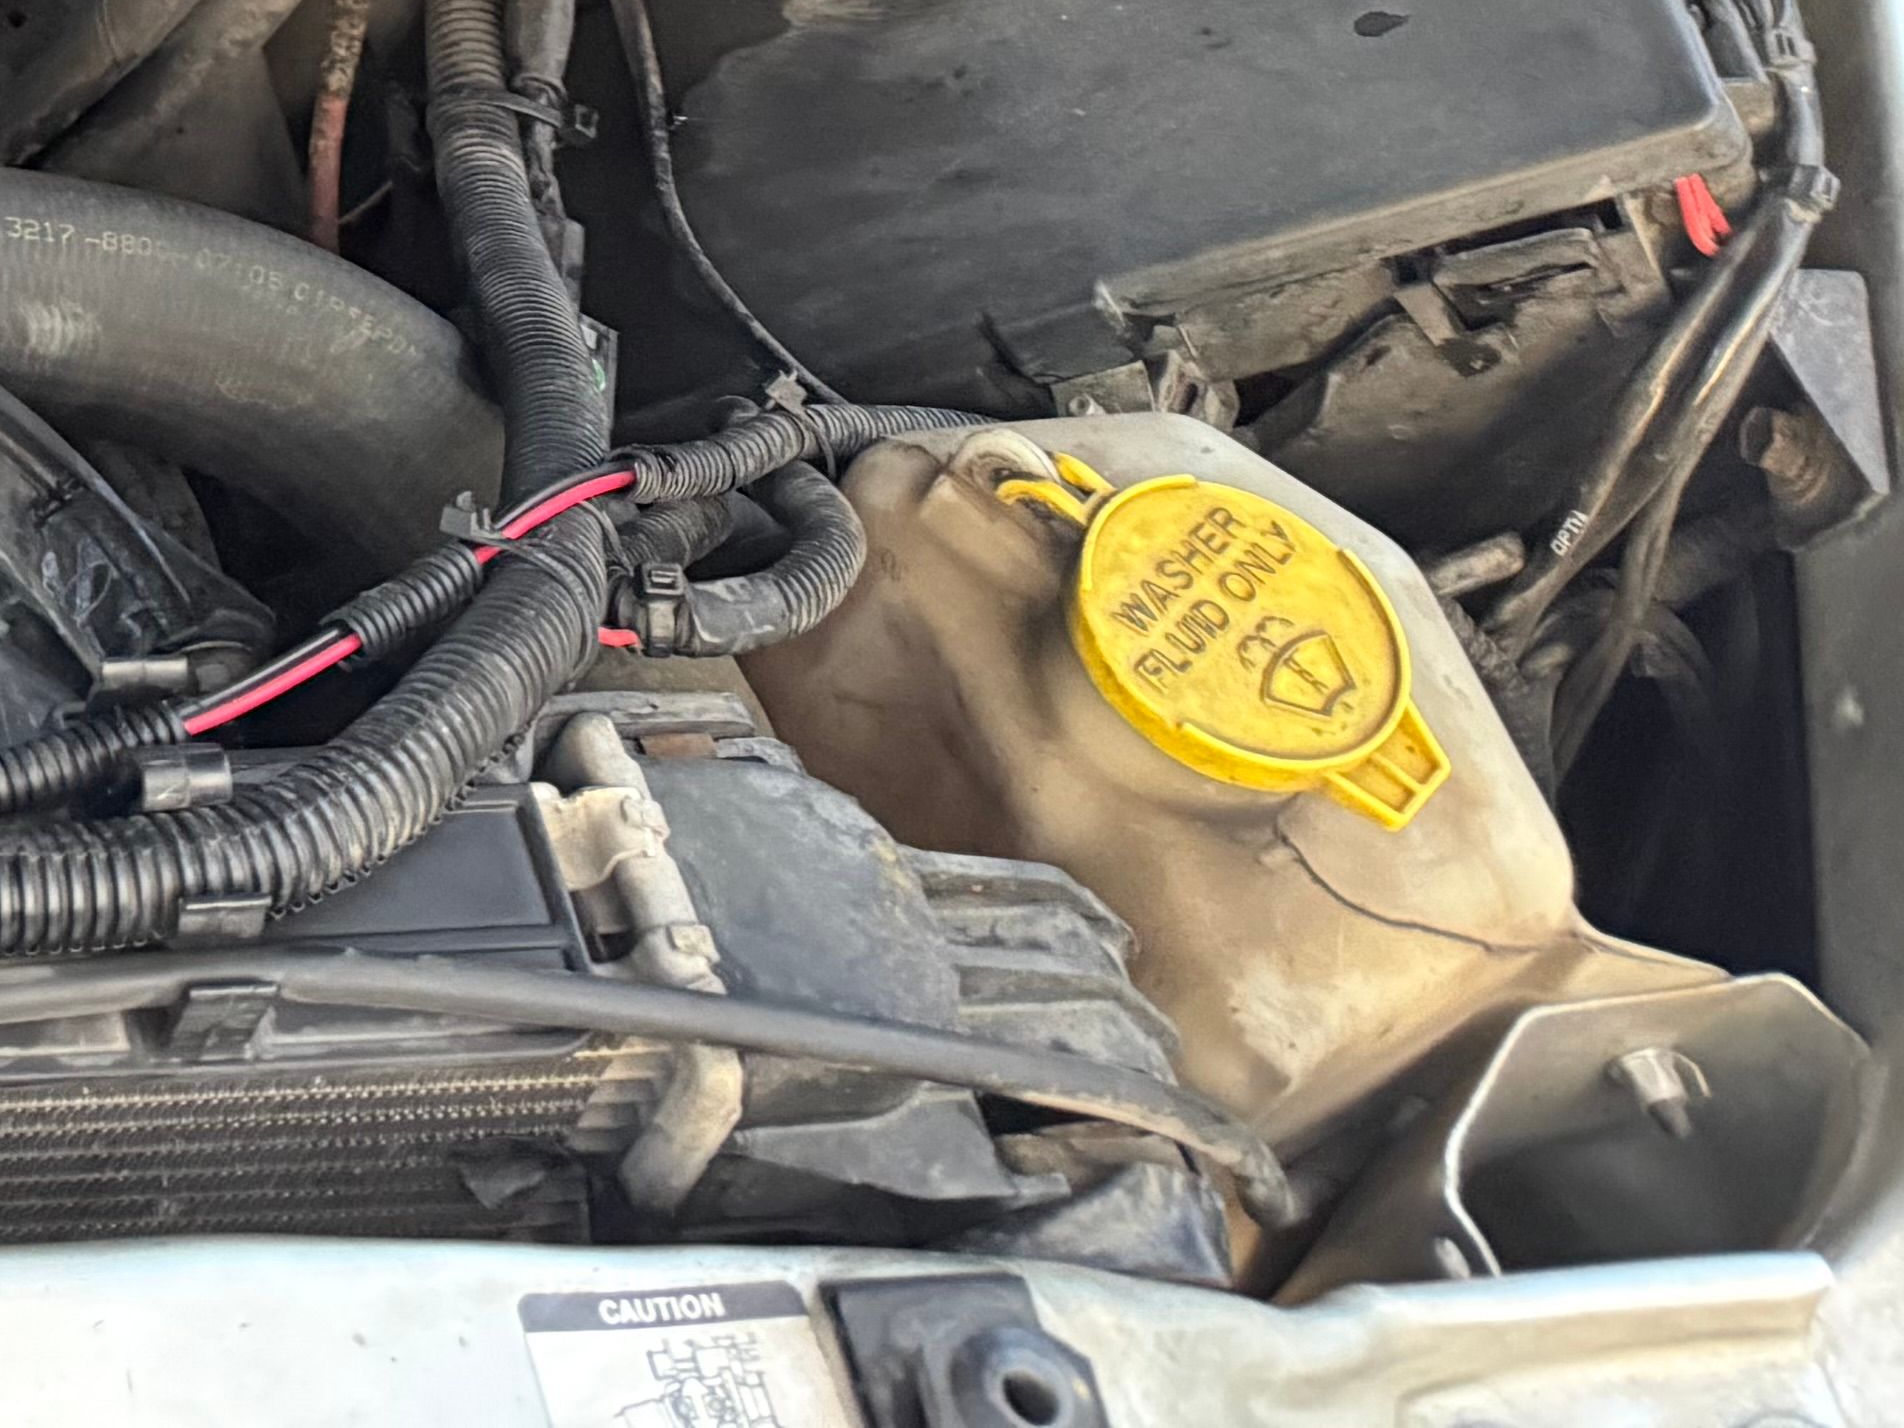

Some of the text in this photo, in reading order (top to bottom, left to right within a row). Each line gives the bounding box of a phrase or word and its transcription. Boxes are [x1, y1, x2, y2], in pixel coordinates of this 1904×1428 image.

[5, 215, 75, 247] 3217
[1111, 507, 1246, 637] WASHER
[1134, 519, 1296, 696] FLUID ONLY
[598, 1293, 726, 1328] CAUTION
